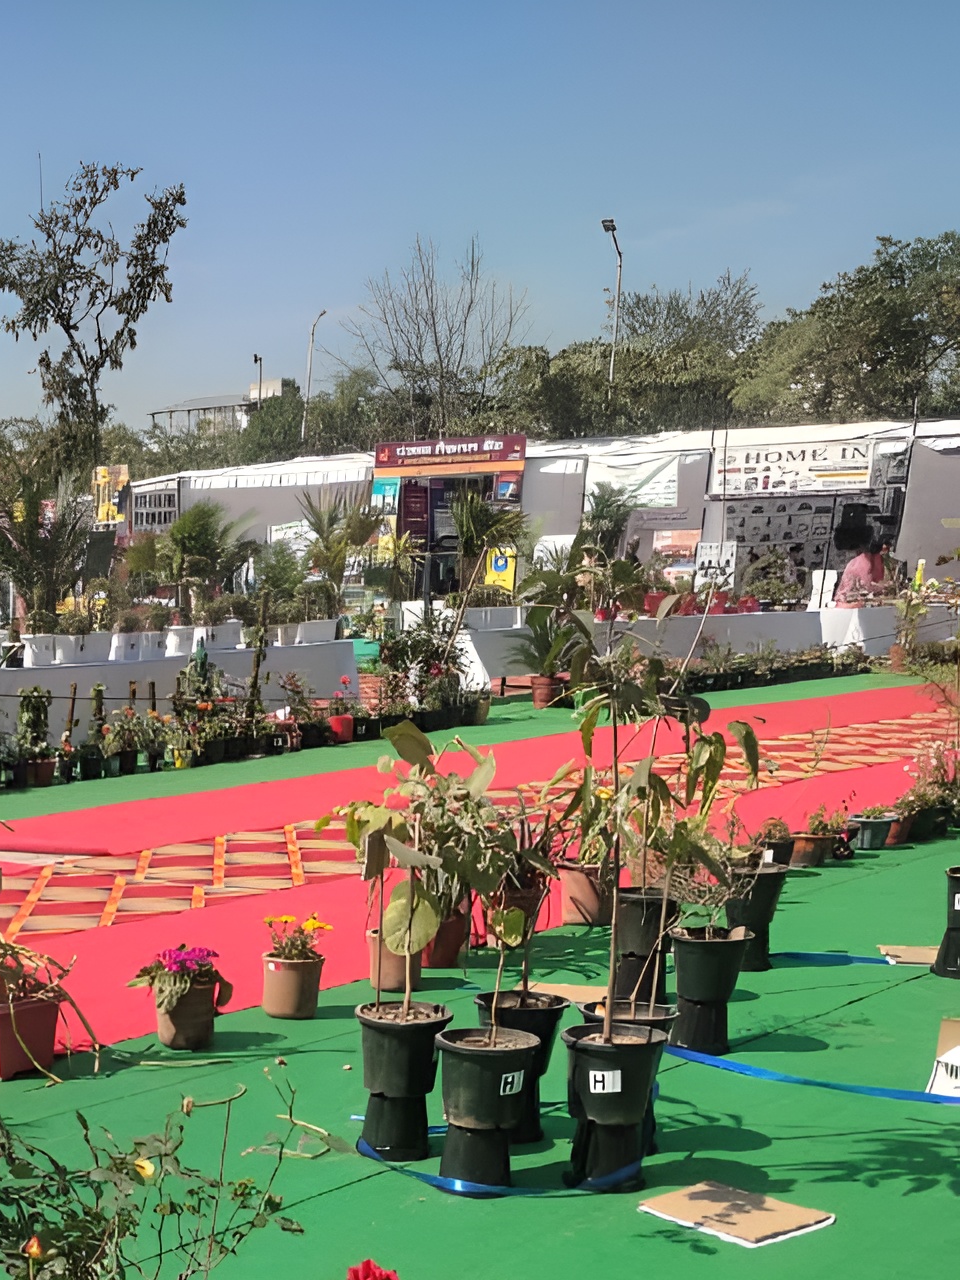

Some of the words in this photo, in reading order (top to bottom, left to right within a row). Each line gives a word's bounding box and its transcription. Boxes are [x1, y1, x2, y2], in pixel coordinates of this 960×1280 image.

[745, 445, 828, 464] HOME
[841, 443, 869, 460] IN
[593, 1074, 606, 1091] H
